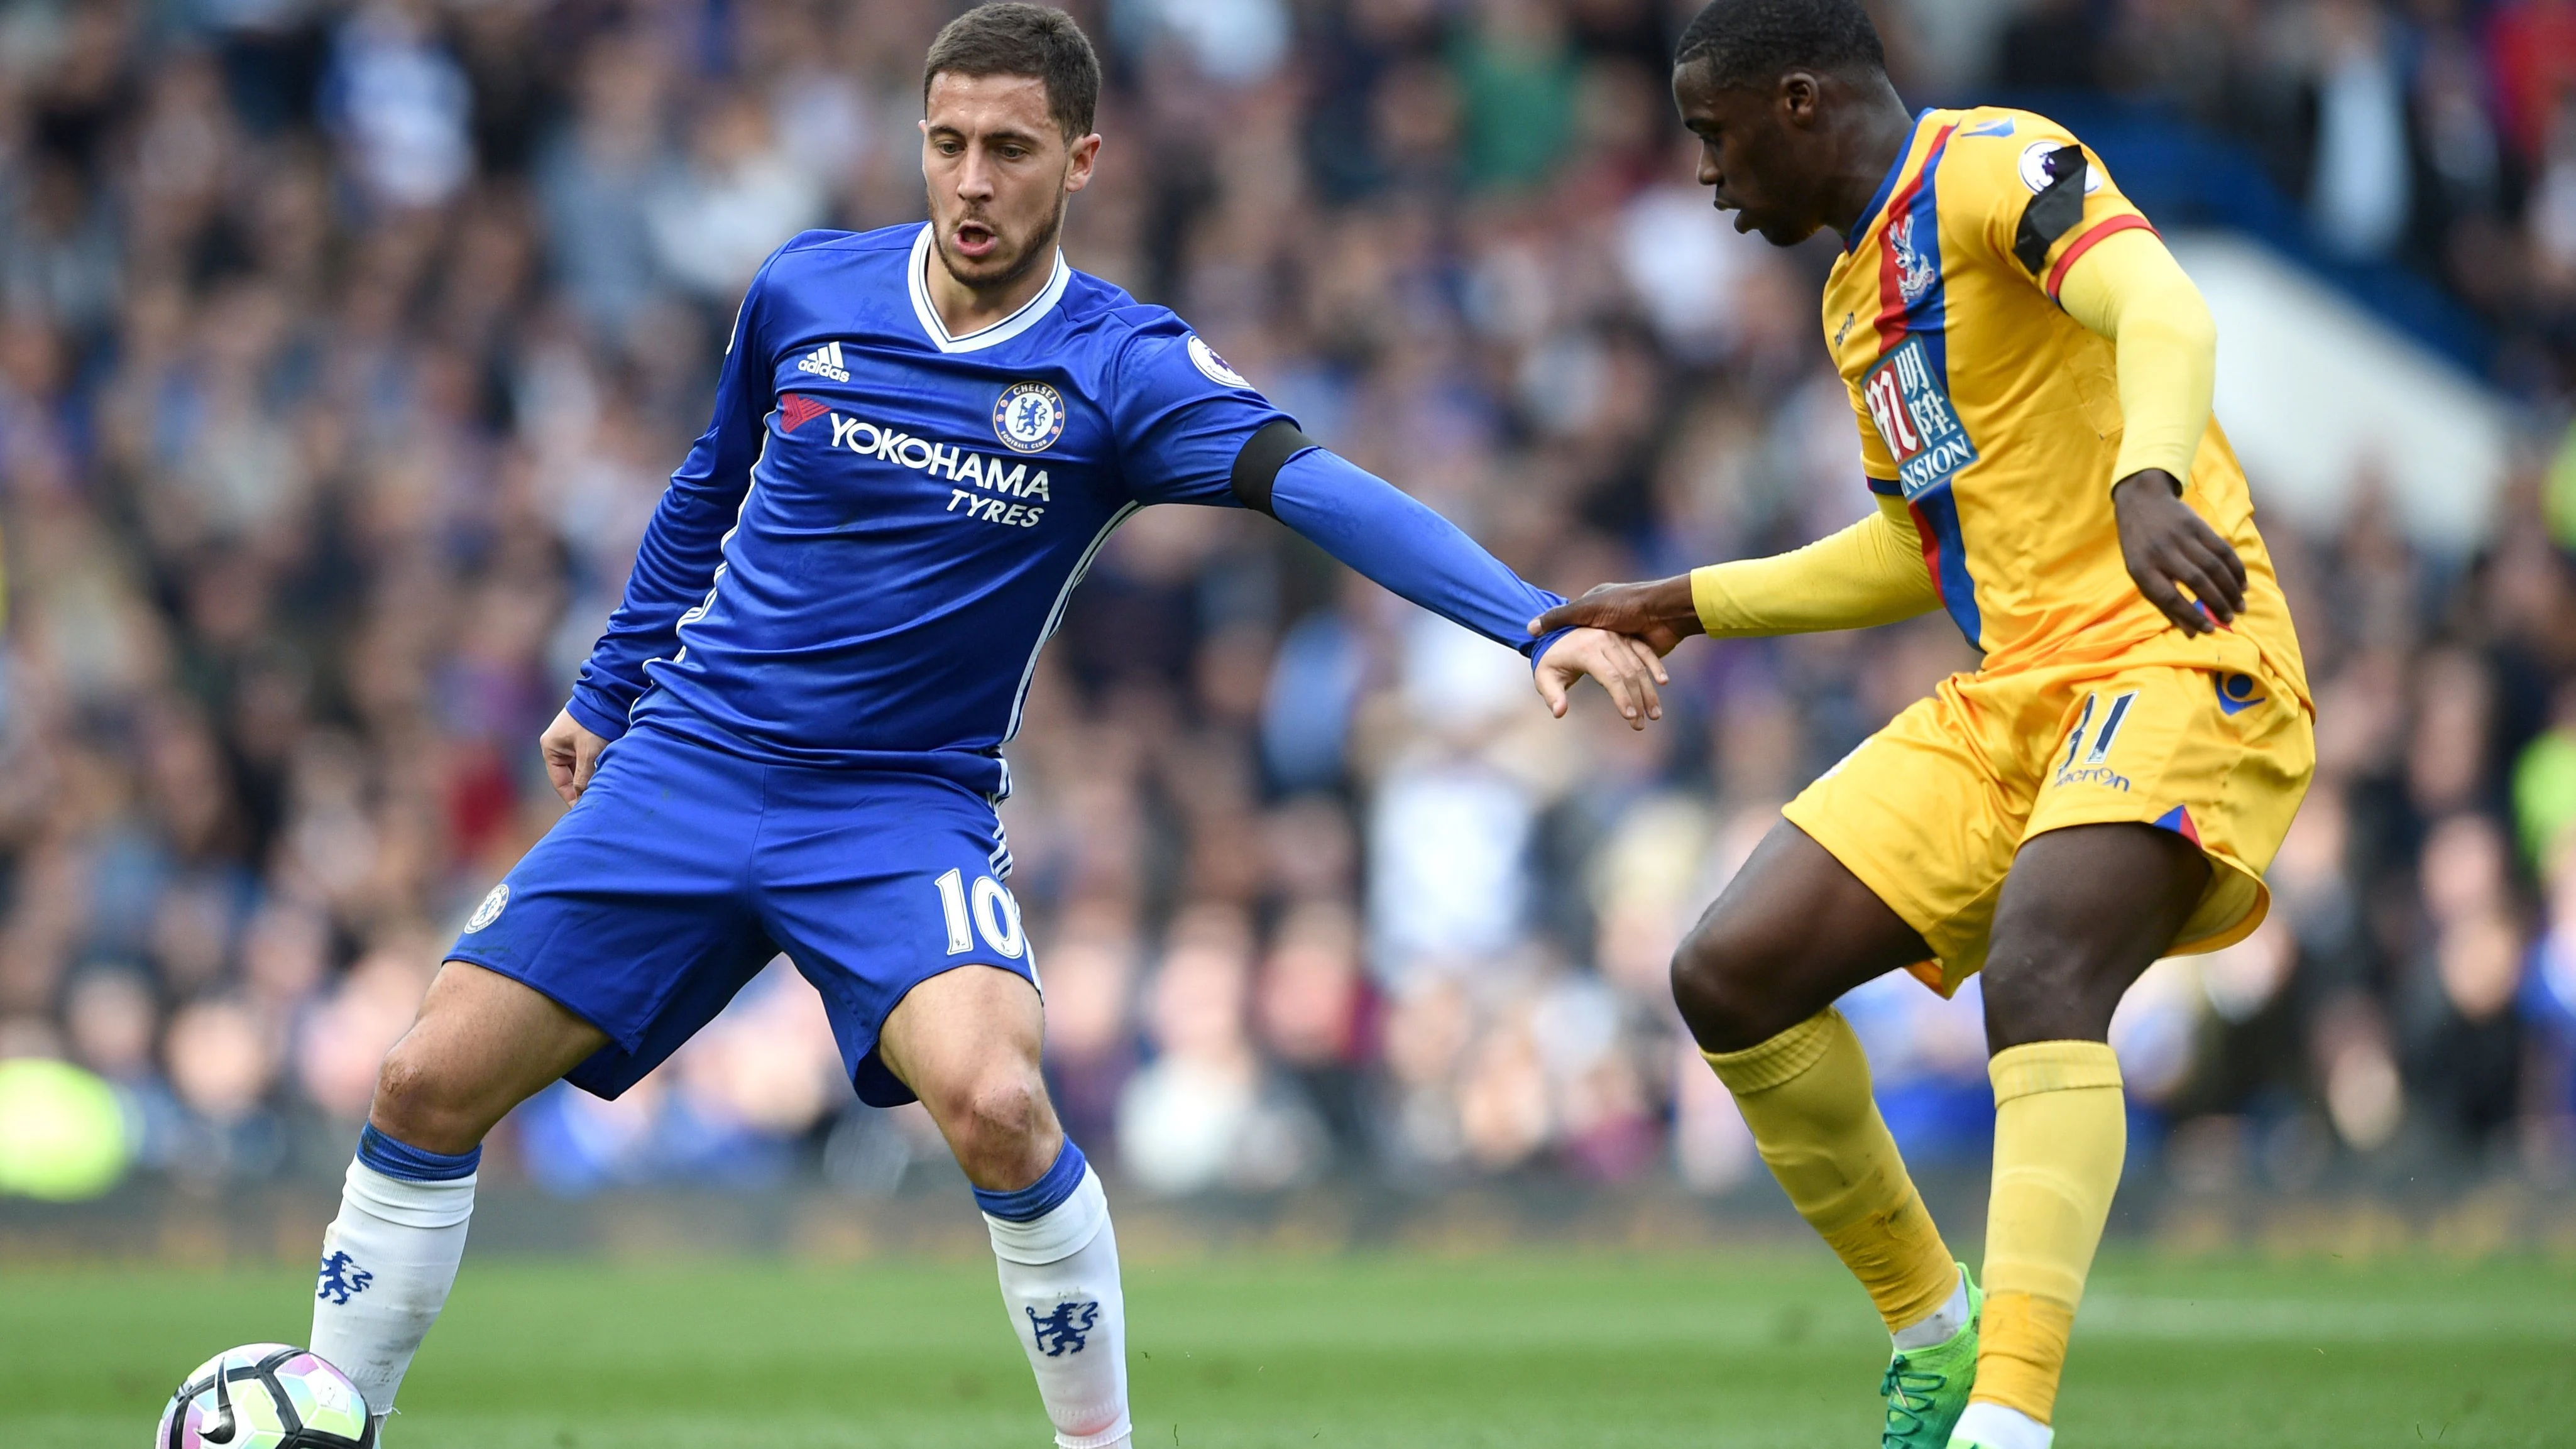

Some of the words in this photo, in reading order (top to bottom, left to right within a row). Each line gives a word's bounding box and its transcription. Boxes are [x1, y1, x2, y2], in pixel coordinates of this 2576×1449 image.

[797, 358, 850, 383] adidas
[1012, 383, 1057, 404] CHELSEA
[1000, 430, 1028, 449] FOOTBALL
[1031, 439, 1048, 449] CLUB
[830, 413, 1050, 502] YOKOHAMA
[946, 488, 1044, 528] TYRES
[934, 867, 1024, 960] 10
